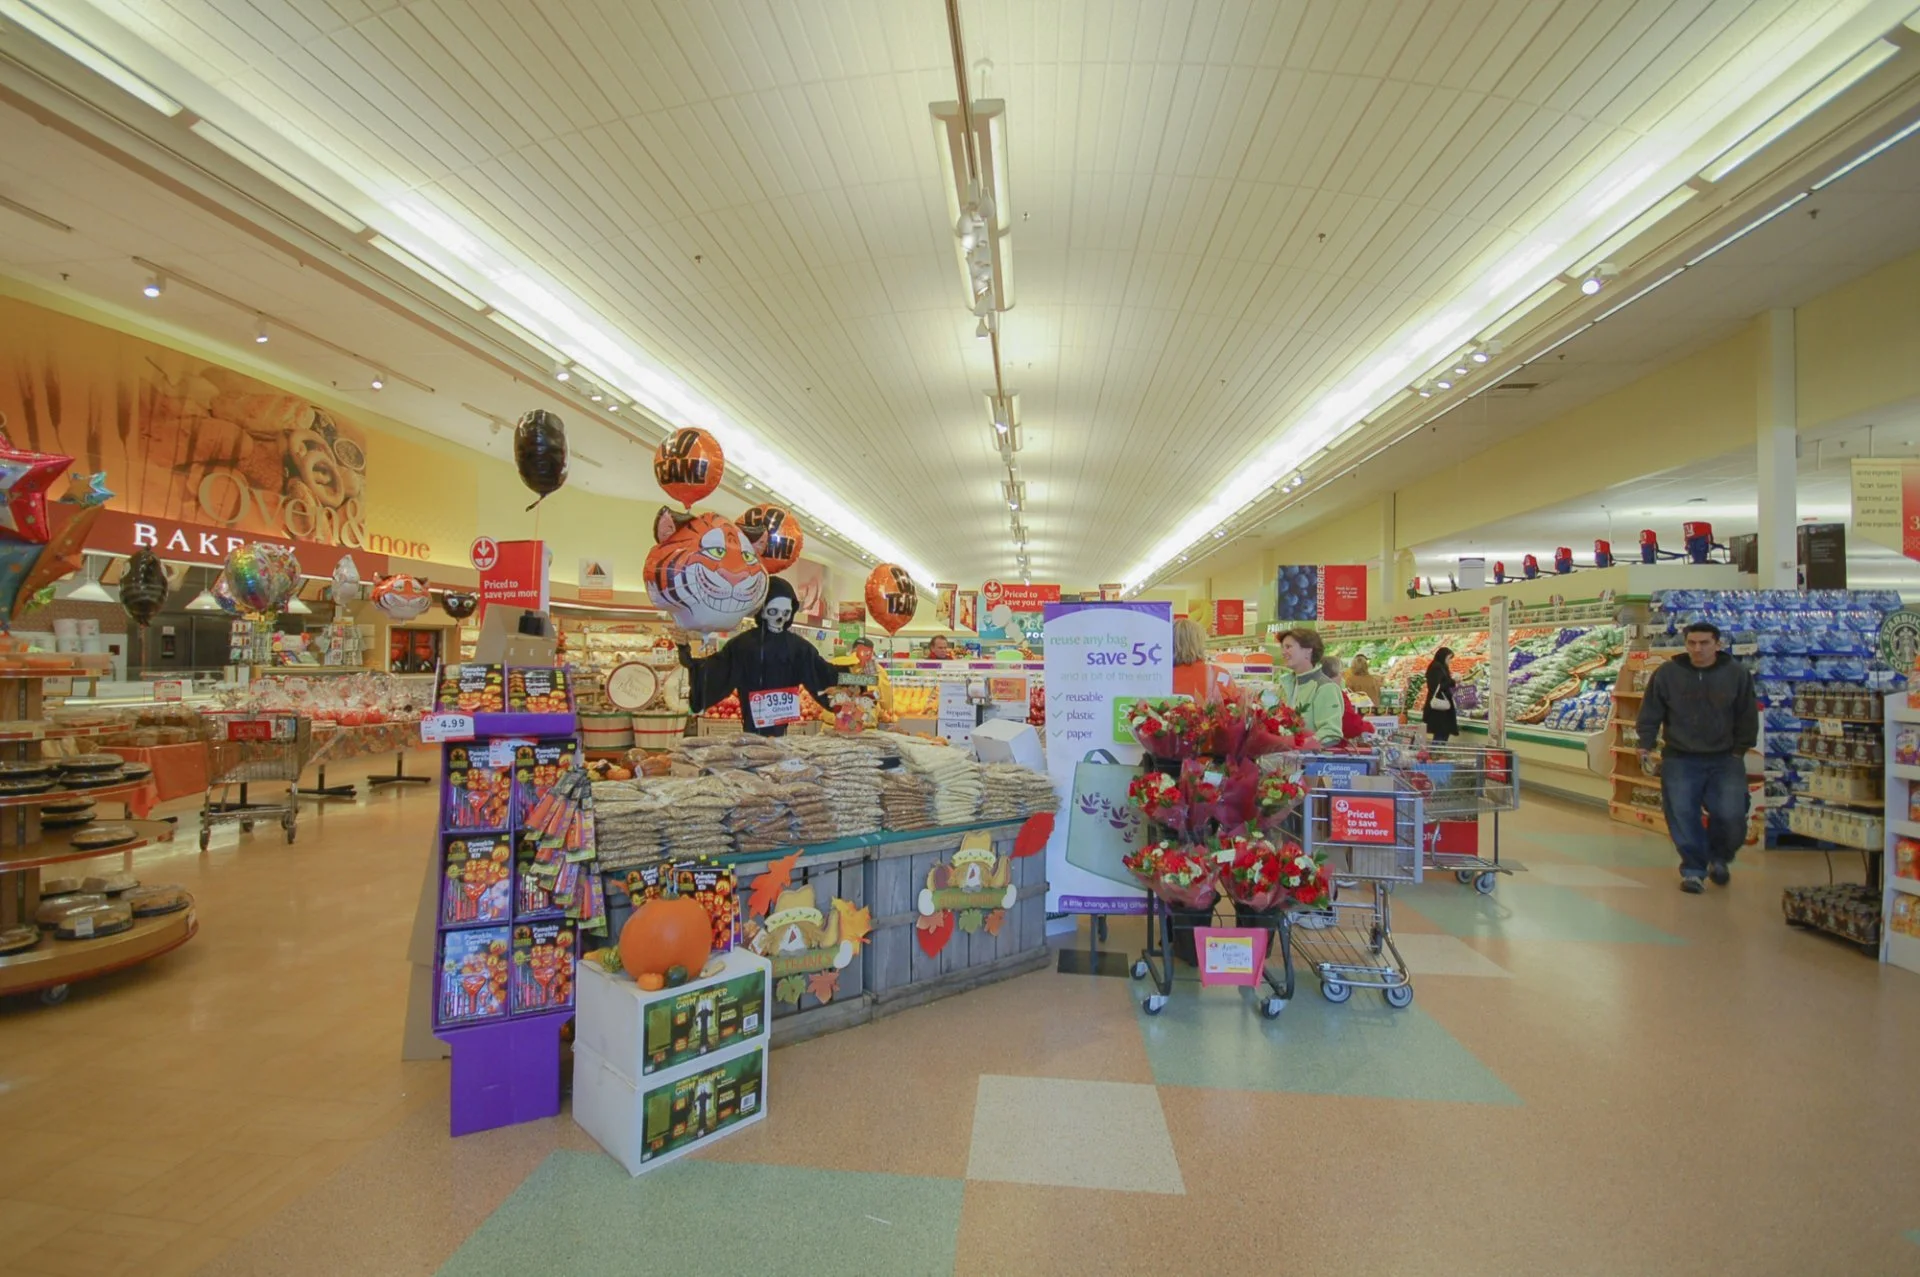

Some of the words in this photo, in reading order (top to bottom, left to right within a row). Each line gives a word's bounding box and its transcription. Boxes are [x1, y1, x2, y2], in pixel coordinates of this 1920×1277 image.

[198, 472, 341, 546] Oven
[369, 532, 431, 560] more
[133, 522, 297, 557] BAKE
[484, 580, 509, 589] Priced
[509, 580, 519, 589] to
[503, 592, 516, 600] you
[1004, 590, 1028, 599] Priced
[1029, 591, 1038, 599] to
[1316, 564, 1326, 623] BLUEBERRIES
[1024, 600, 1037, 608] you
[1051, 636, 1080, 645] reuse
[1083, 637, 1103, 646] any
[1107, 633, 1128, 646] bag
[1087, 652, 1127, 665] save
[1132, 643, 1163, 666] 5¢
[1061, 671, 1079, 680] and
[1090, 671, 1104, 680] bit
[1105, 671, 1116, 680] of
[1118, 671, 1134, 680] the
[1136, 671, 1162, 680] earth
[1065, 692, 1103, 701] reusable
[1066, 710, 1095, 722] plastic
[1066, 731, 1093, 741] paper
[1347, 810, 1375, 819] Priced
[1347, 819, 1358, 827] to
[1347, 828, 1363, 836] you
[641, 868, 658, 877] Pump
[1069, 899, 1083, 908] little
[1084, 901, 1111, 910] change,
[1117, 901, 1128, 910] big
